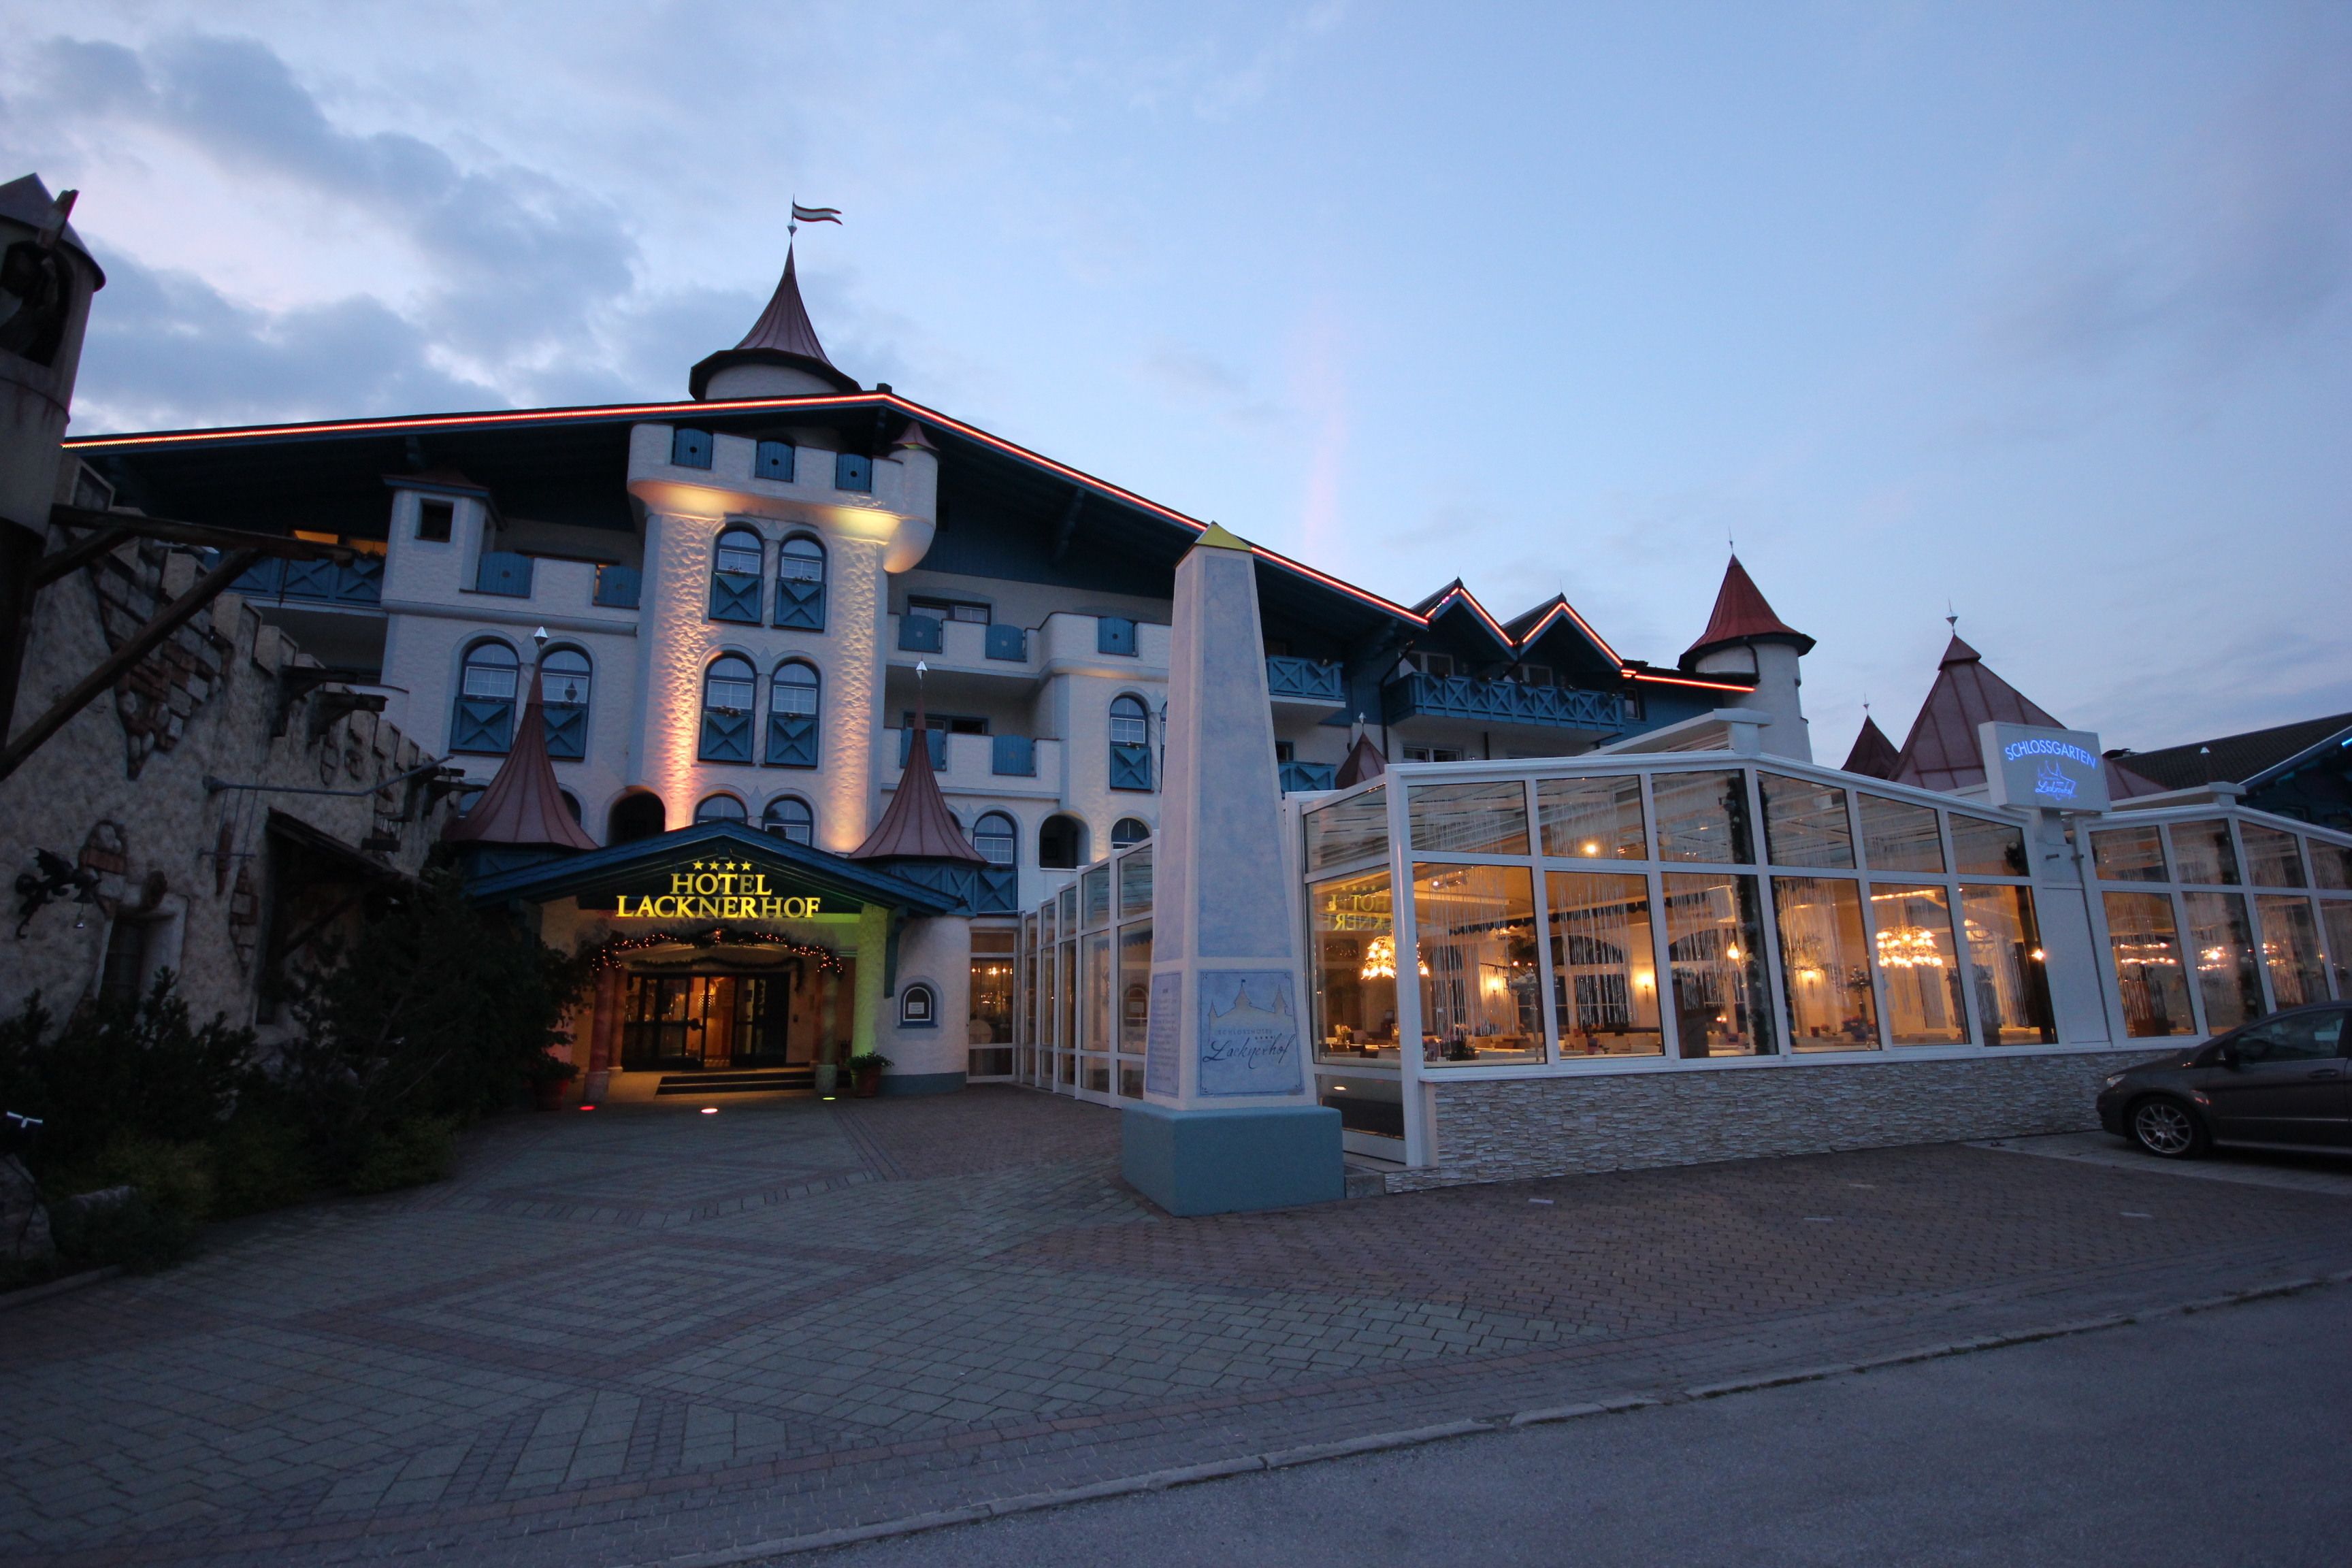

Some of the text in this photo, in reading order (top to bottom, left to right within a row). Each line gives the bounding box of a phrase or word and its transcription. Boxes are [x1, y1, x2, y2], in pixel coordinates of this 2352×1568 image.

[2004, 739, 2097, 769] SCHLOSSGARTEN
[670, 873, 772, 896] HOTEL
[615, 895, 821, 919] LACKNERHOF
[1202, 1032, 1296, 1069] Lacknerhof
